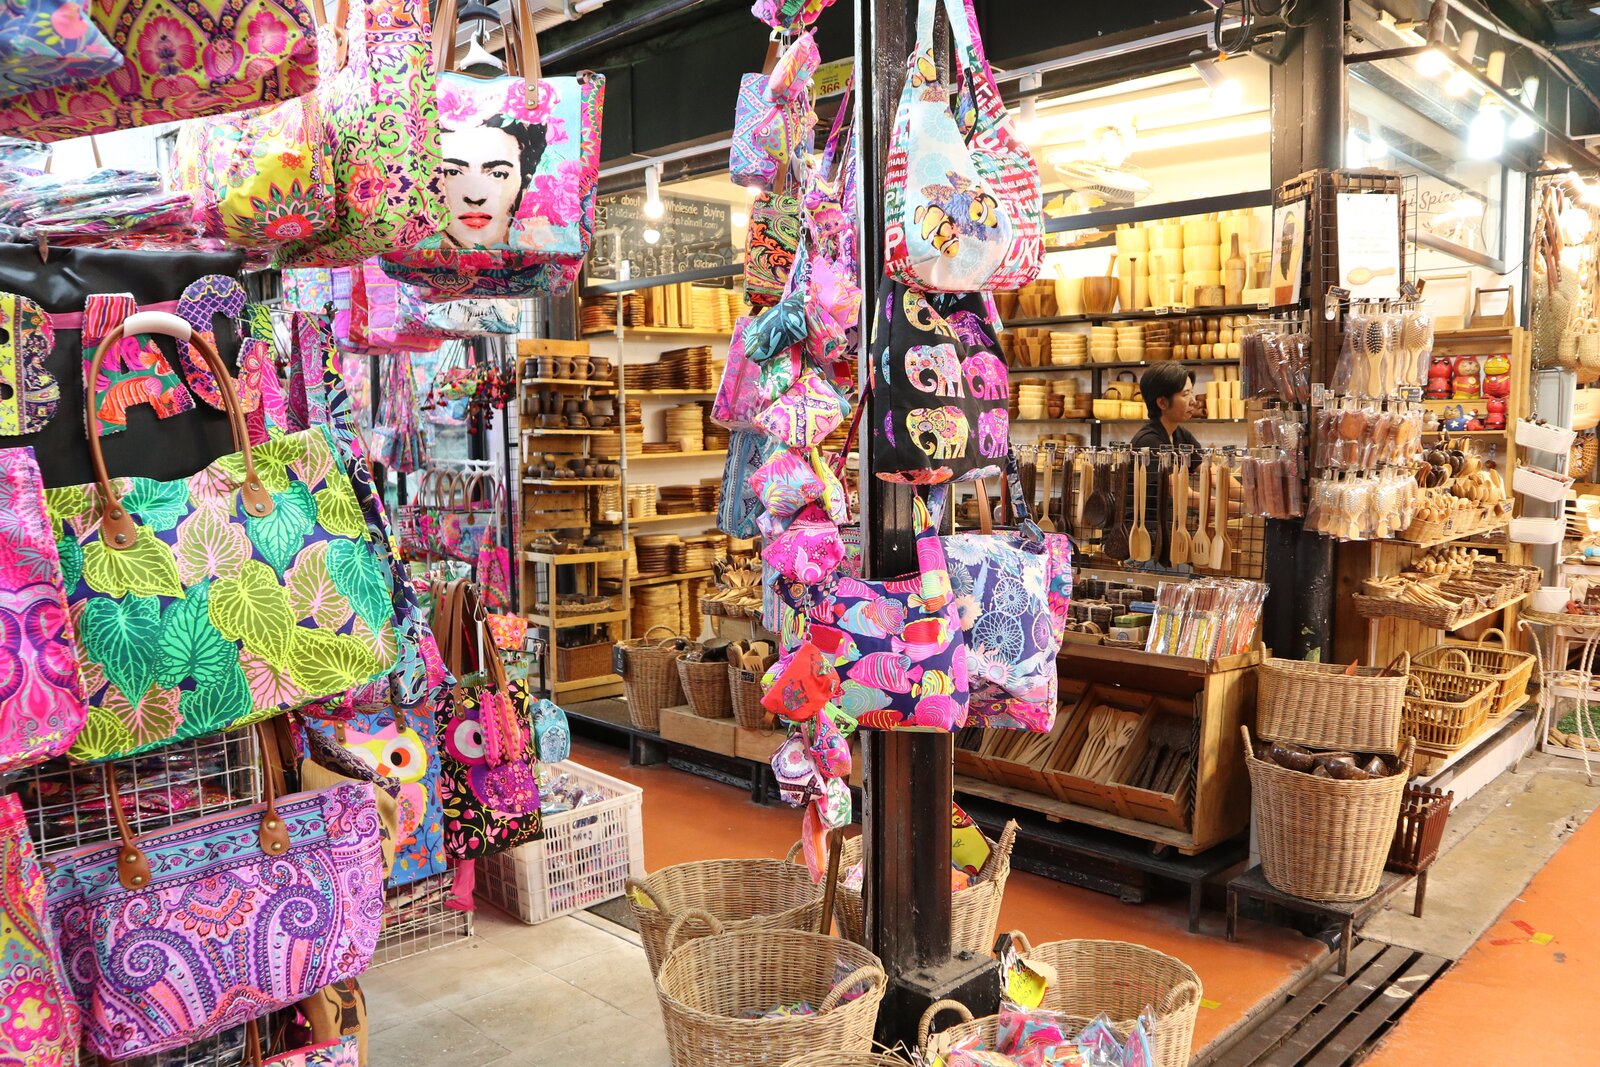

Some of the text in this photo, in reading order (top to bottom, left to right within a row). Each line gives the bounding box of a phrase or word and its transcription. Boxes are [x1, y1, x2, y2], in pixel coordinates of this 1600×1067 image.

[621, 195, 641, 208] about
[664, 199, 698, 215] Wholesale
[703, 203, 725, 222] Buying
[693, 259, 718, 269] Kitchen
